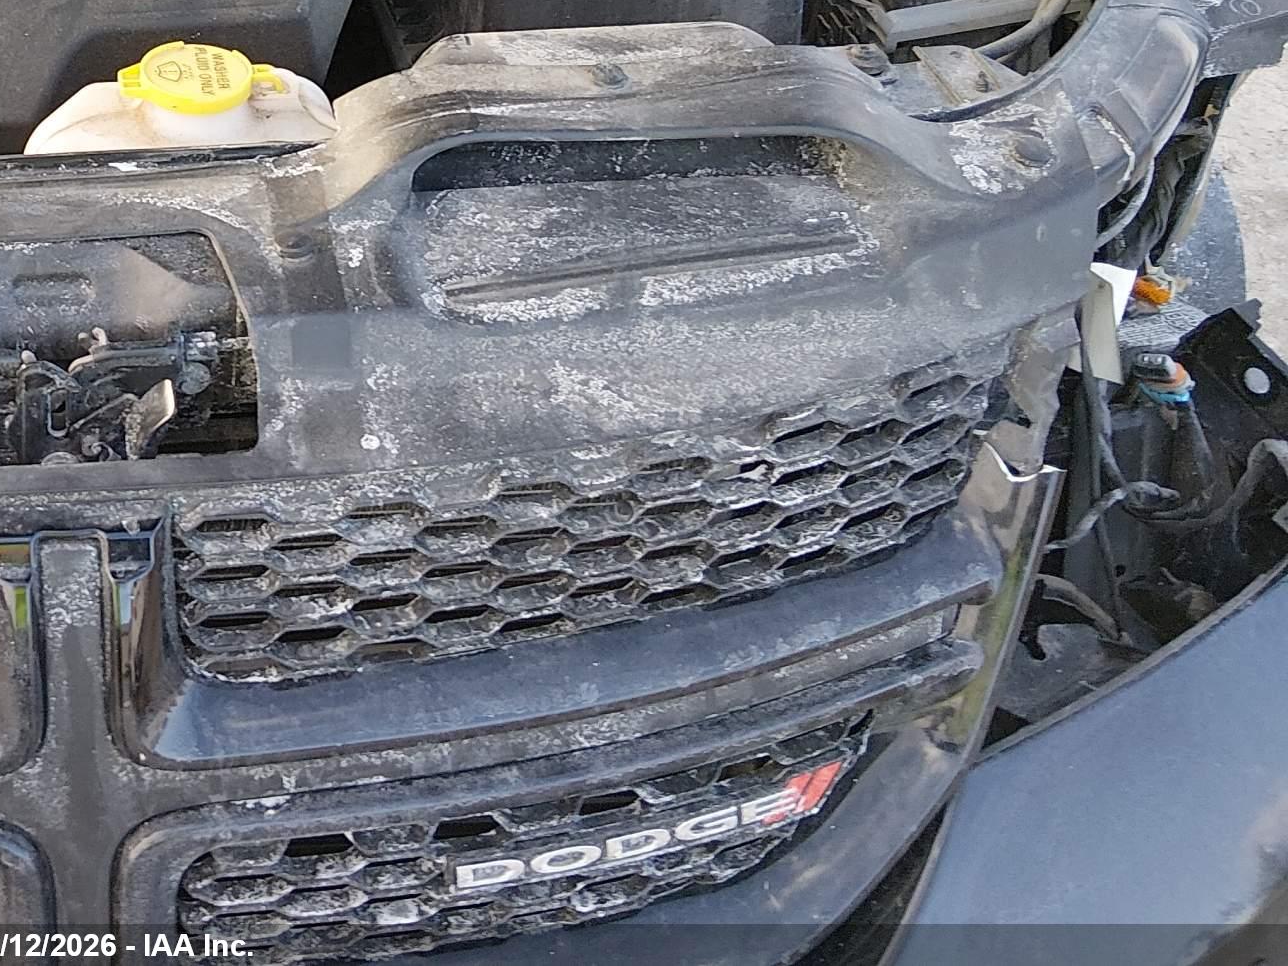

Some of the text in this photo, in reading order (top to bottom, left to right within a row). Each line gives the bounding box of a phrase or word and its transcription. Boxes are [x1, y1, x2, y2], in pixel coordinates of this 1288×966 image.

[194, 46, 216, 96] FLUID ONLY
[211, 53, 231, 89] WASHER
[455, 787, 802, 889] DODGE
